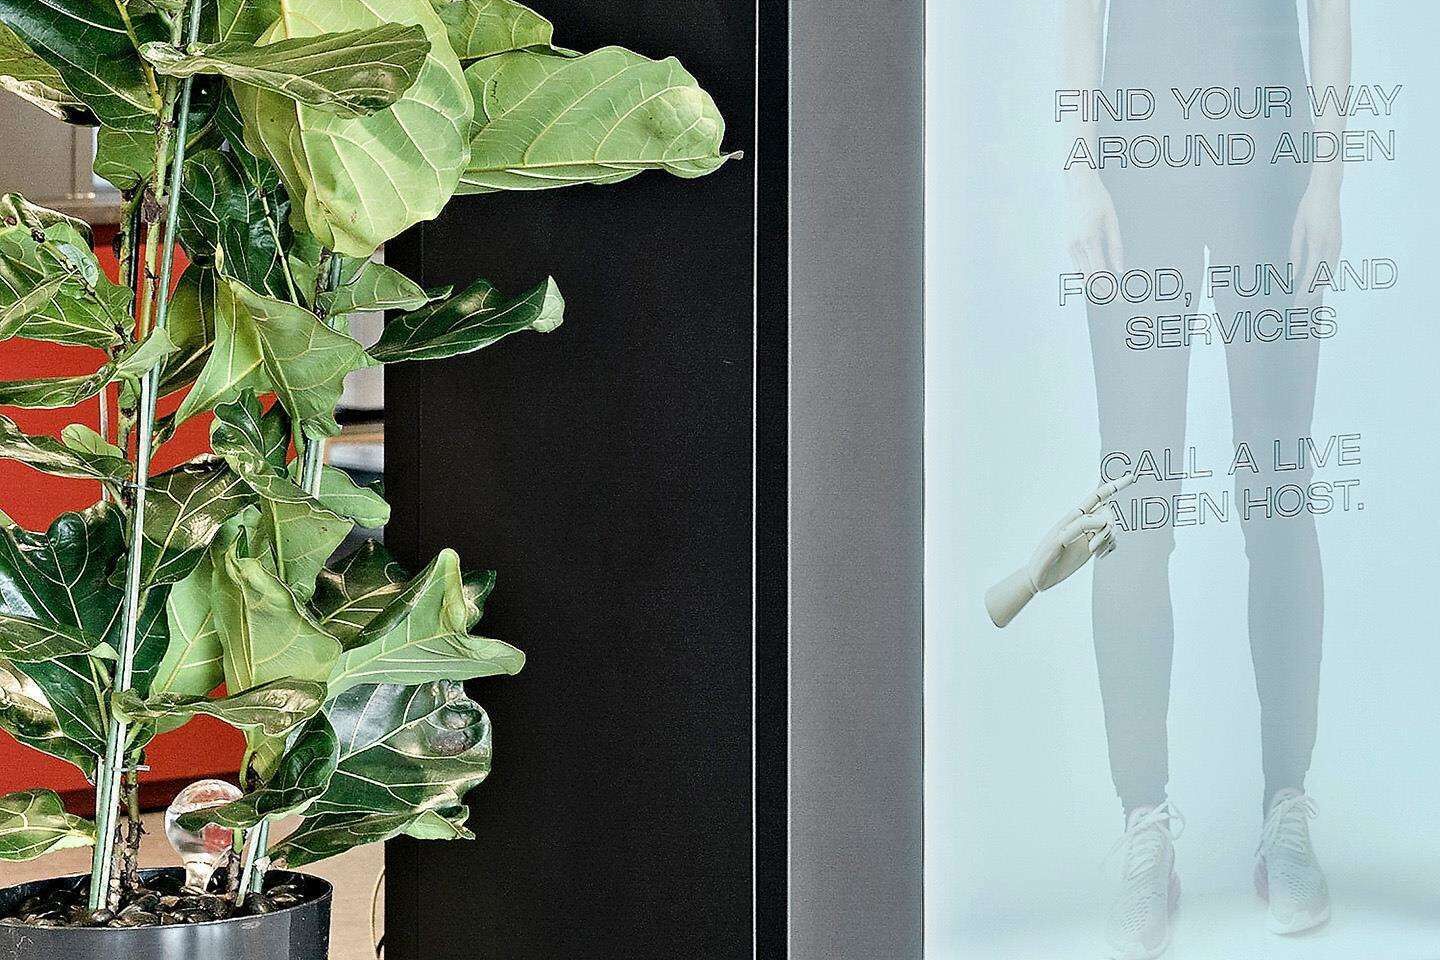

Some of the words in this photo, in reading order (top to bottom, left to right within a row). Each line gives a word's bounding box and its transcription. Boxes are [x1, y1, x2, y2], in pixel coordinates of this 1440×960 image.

[1054, 88, 1156, 122] FIND
[1171, 86, 1292, 120] YOUR
[1305, 84, 1403, 117] WAY
[1063, 132, 1256, 171] AROUND
[1271, 129, 1396, 164] AIDEN
[1058, 268, 1192, 307] FOOD,
[1206, 263, 1294, 298] FUN
[1308, 258, 1399, 294] AND
[1125, 305, 1339, 350] SERVICES
[1100, 447, 1213, 484] CALL
[1228, 442, 1259, 476] A
[1274, 433, 1362, 472] LIVE
[1108, 490, 1229, 533] AIDEN
[1243, 479, 1365, 521] HOST.
